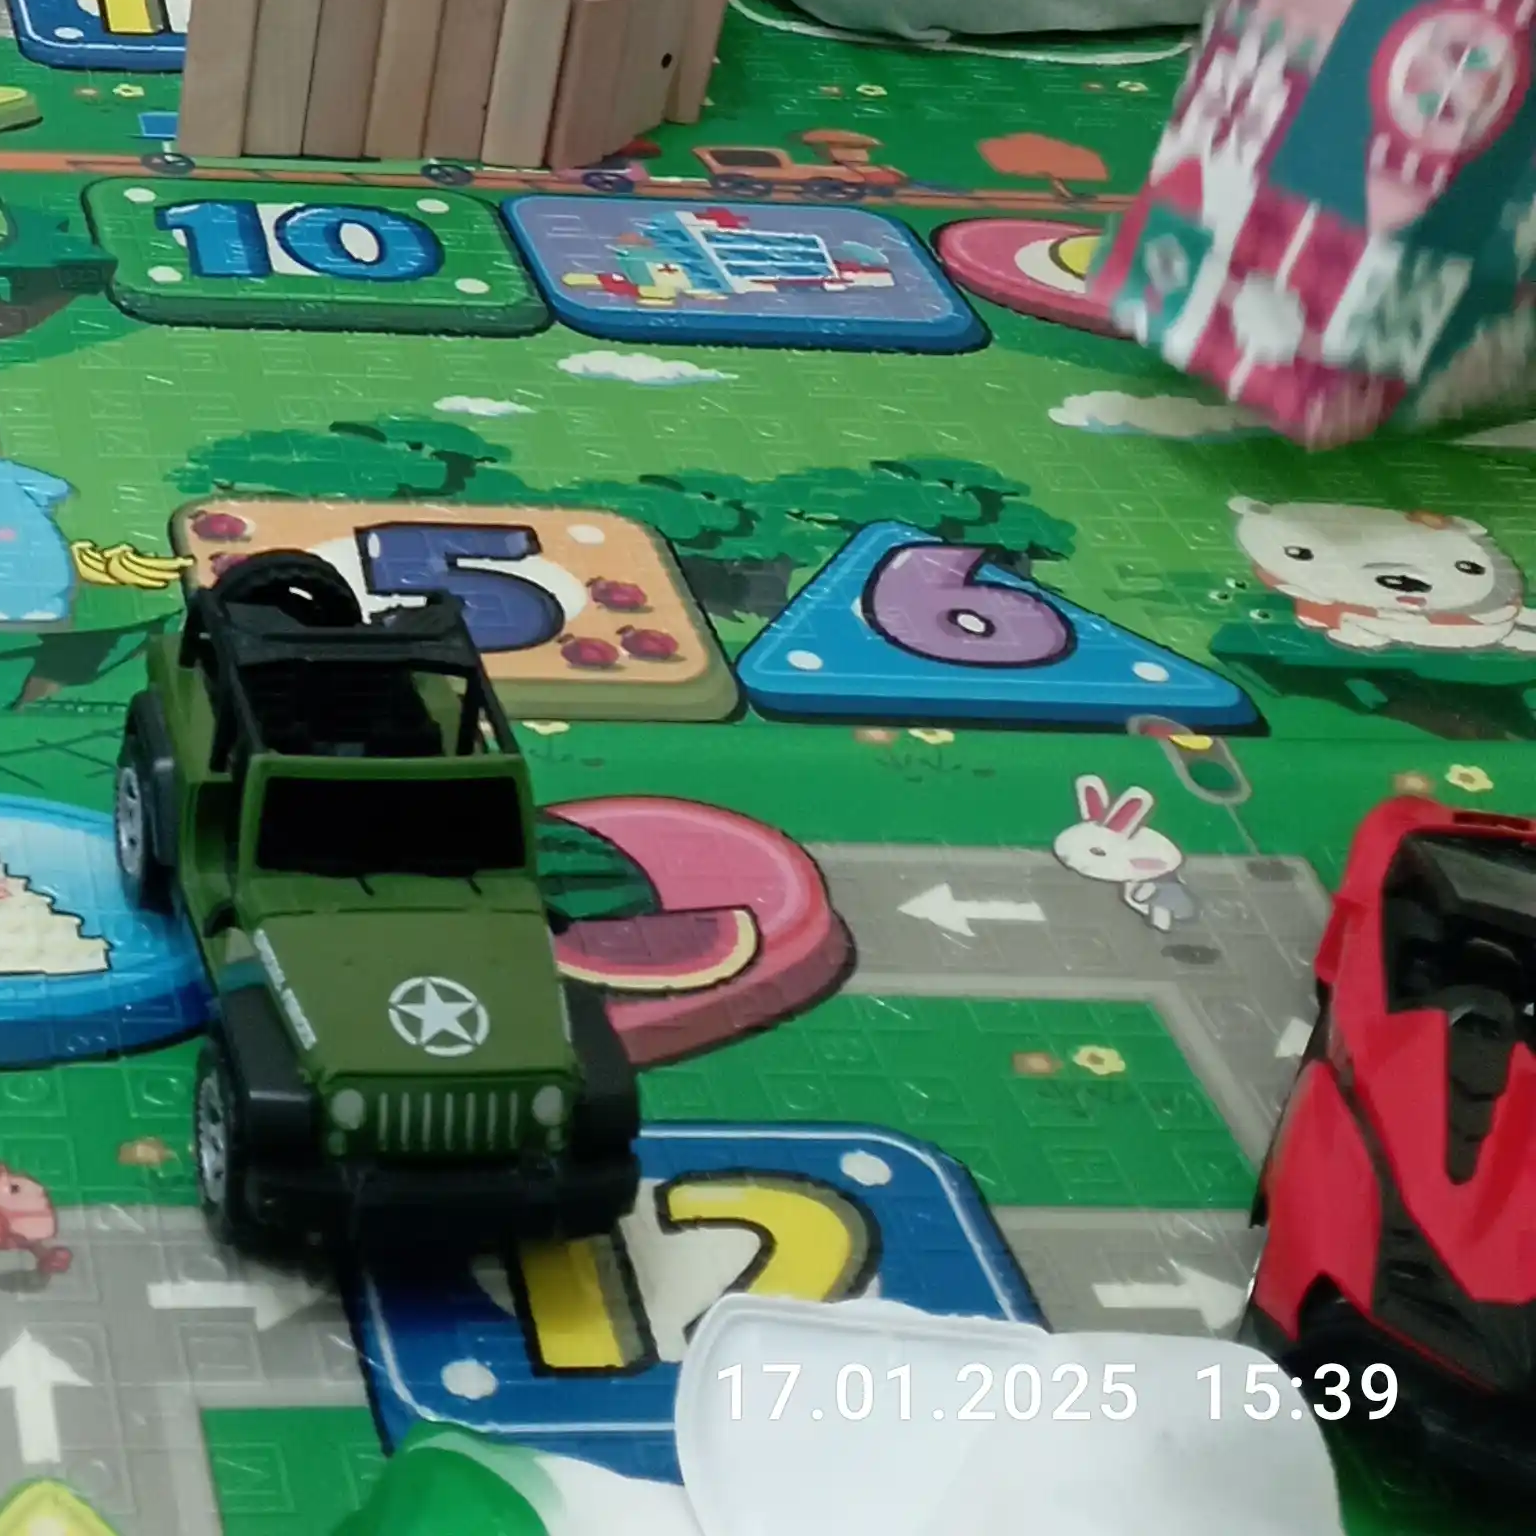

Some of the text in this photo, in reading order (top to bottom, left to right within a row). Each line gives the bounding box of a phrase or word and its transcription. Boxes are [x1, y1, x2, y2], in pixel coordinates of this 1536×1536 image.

[155, 199, 442, 281] 10
[354, 521, 566, 651] 5
[864, 542, 1077, 667] 6
